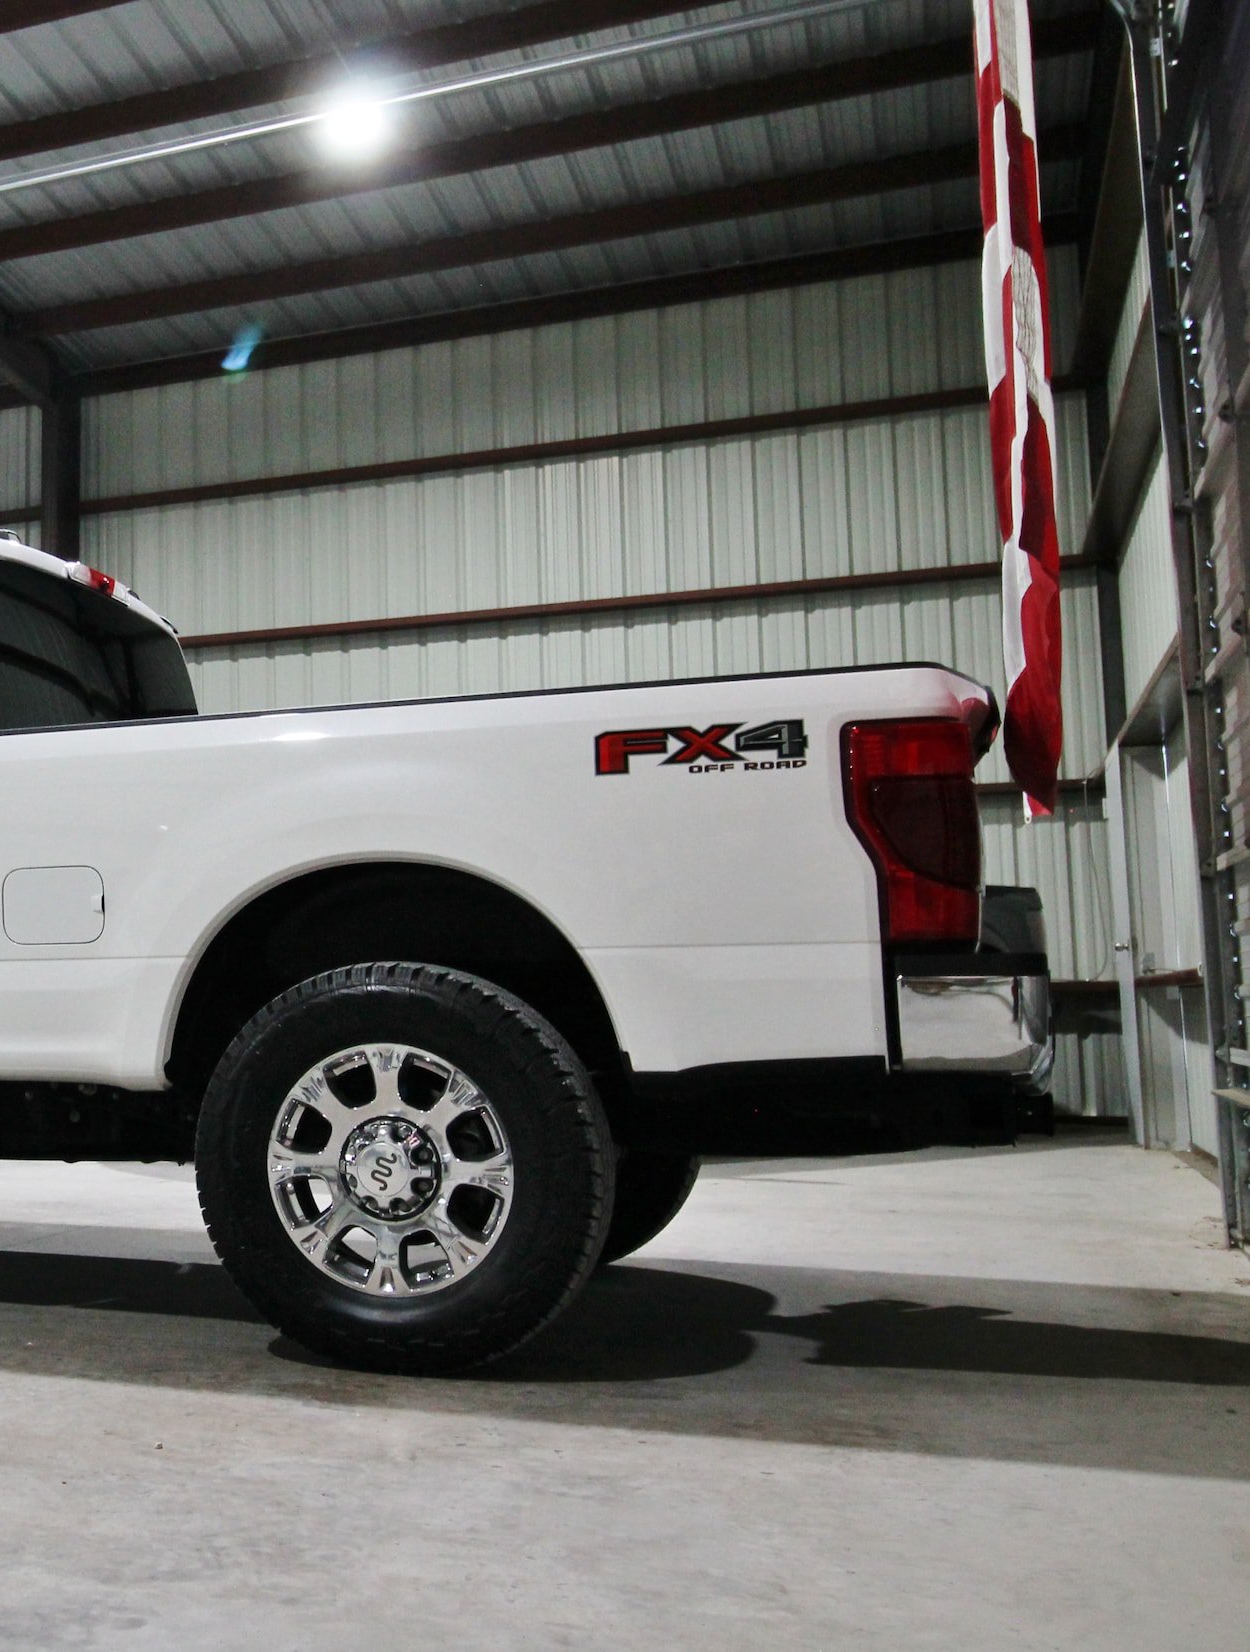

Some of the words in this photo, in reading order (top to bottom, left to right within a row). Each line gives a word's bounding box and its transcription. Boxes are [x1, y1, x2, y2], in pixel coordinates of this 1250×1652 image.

[595, 719, 808, 775] FX4
[688, 764, 735, 774] OFF
[744, 760, 808, 771] ROAD
